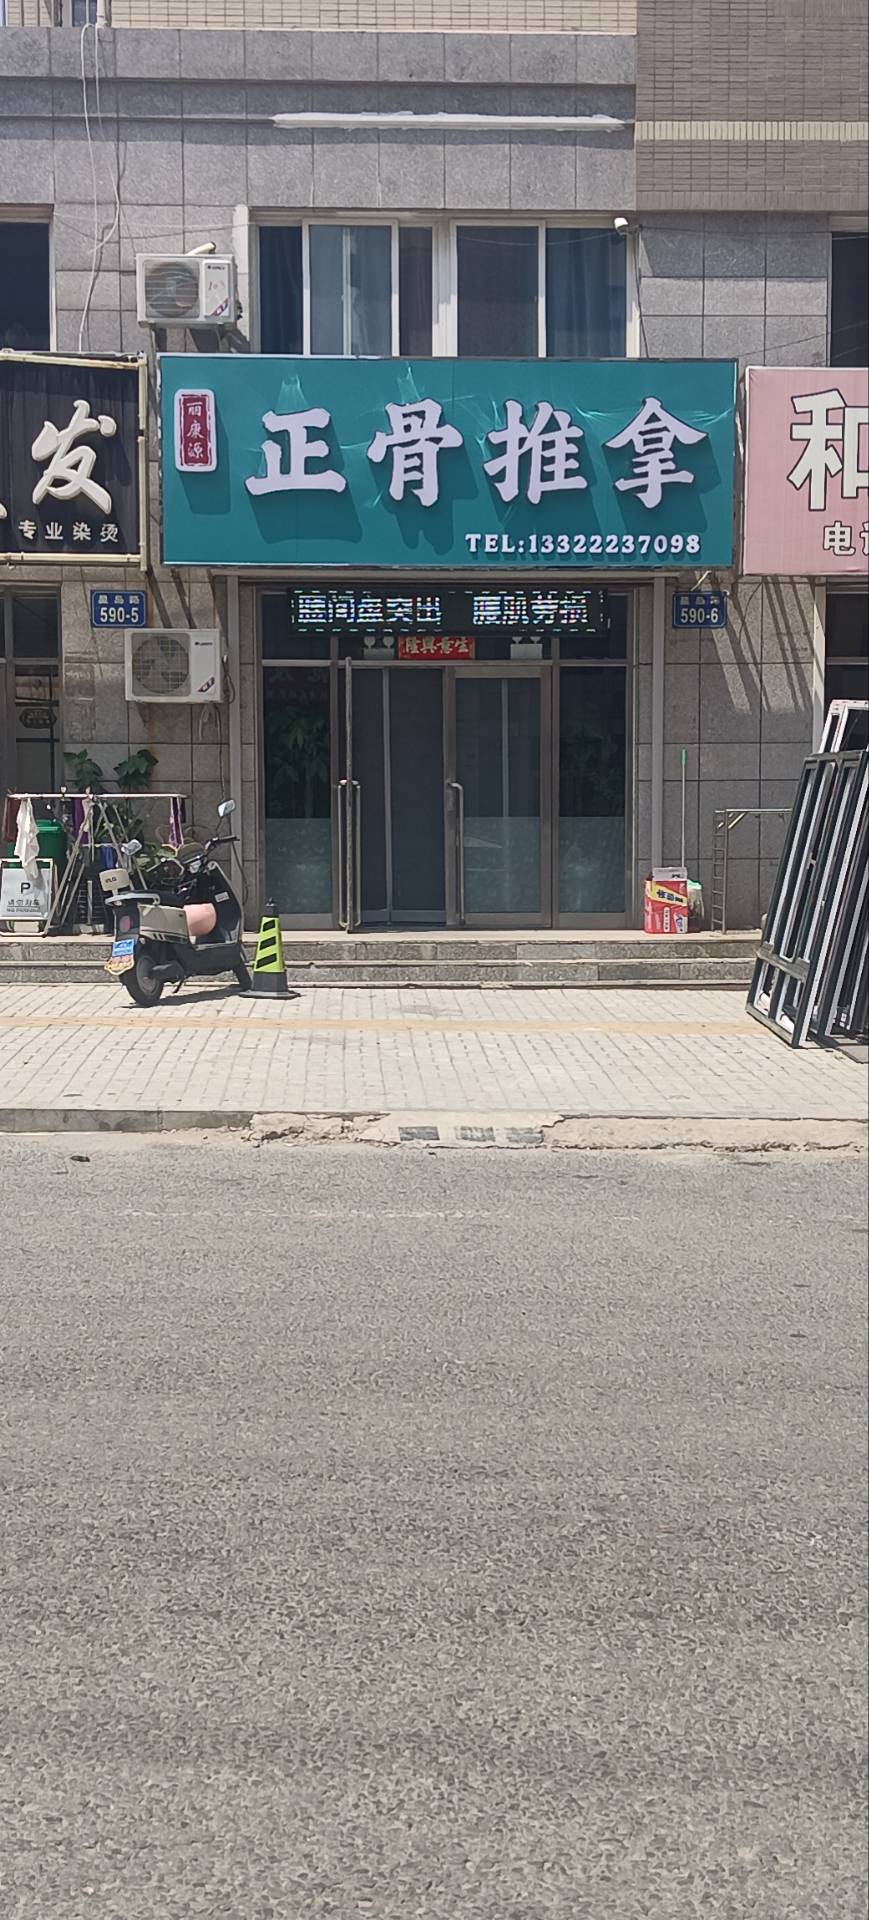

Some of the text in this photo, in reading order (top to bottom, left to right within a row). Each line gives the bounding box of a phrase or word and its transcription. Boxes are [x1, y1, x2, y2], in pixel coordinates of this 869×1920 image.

[186, 401, 205, 460] 丽康源
[0, 399, 117, 516] 发
[244, 396, 709, 509] 正骨推拿
[787, 388, 868, 512] 和
[18, 519, 119, 543] 专业染烫
[464, 533, 701, 555] TEL:13322237098
[822, 520, 868, 556] 电
[100, 606, 139, 623] 590-5
[680, 607, 719, 623] 590-6
[20, 882, 31, 895] P
